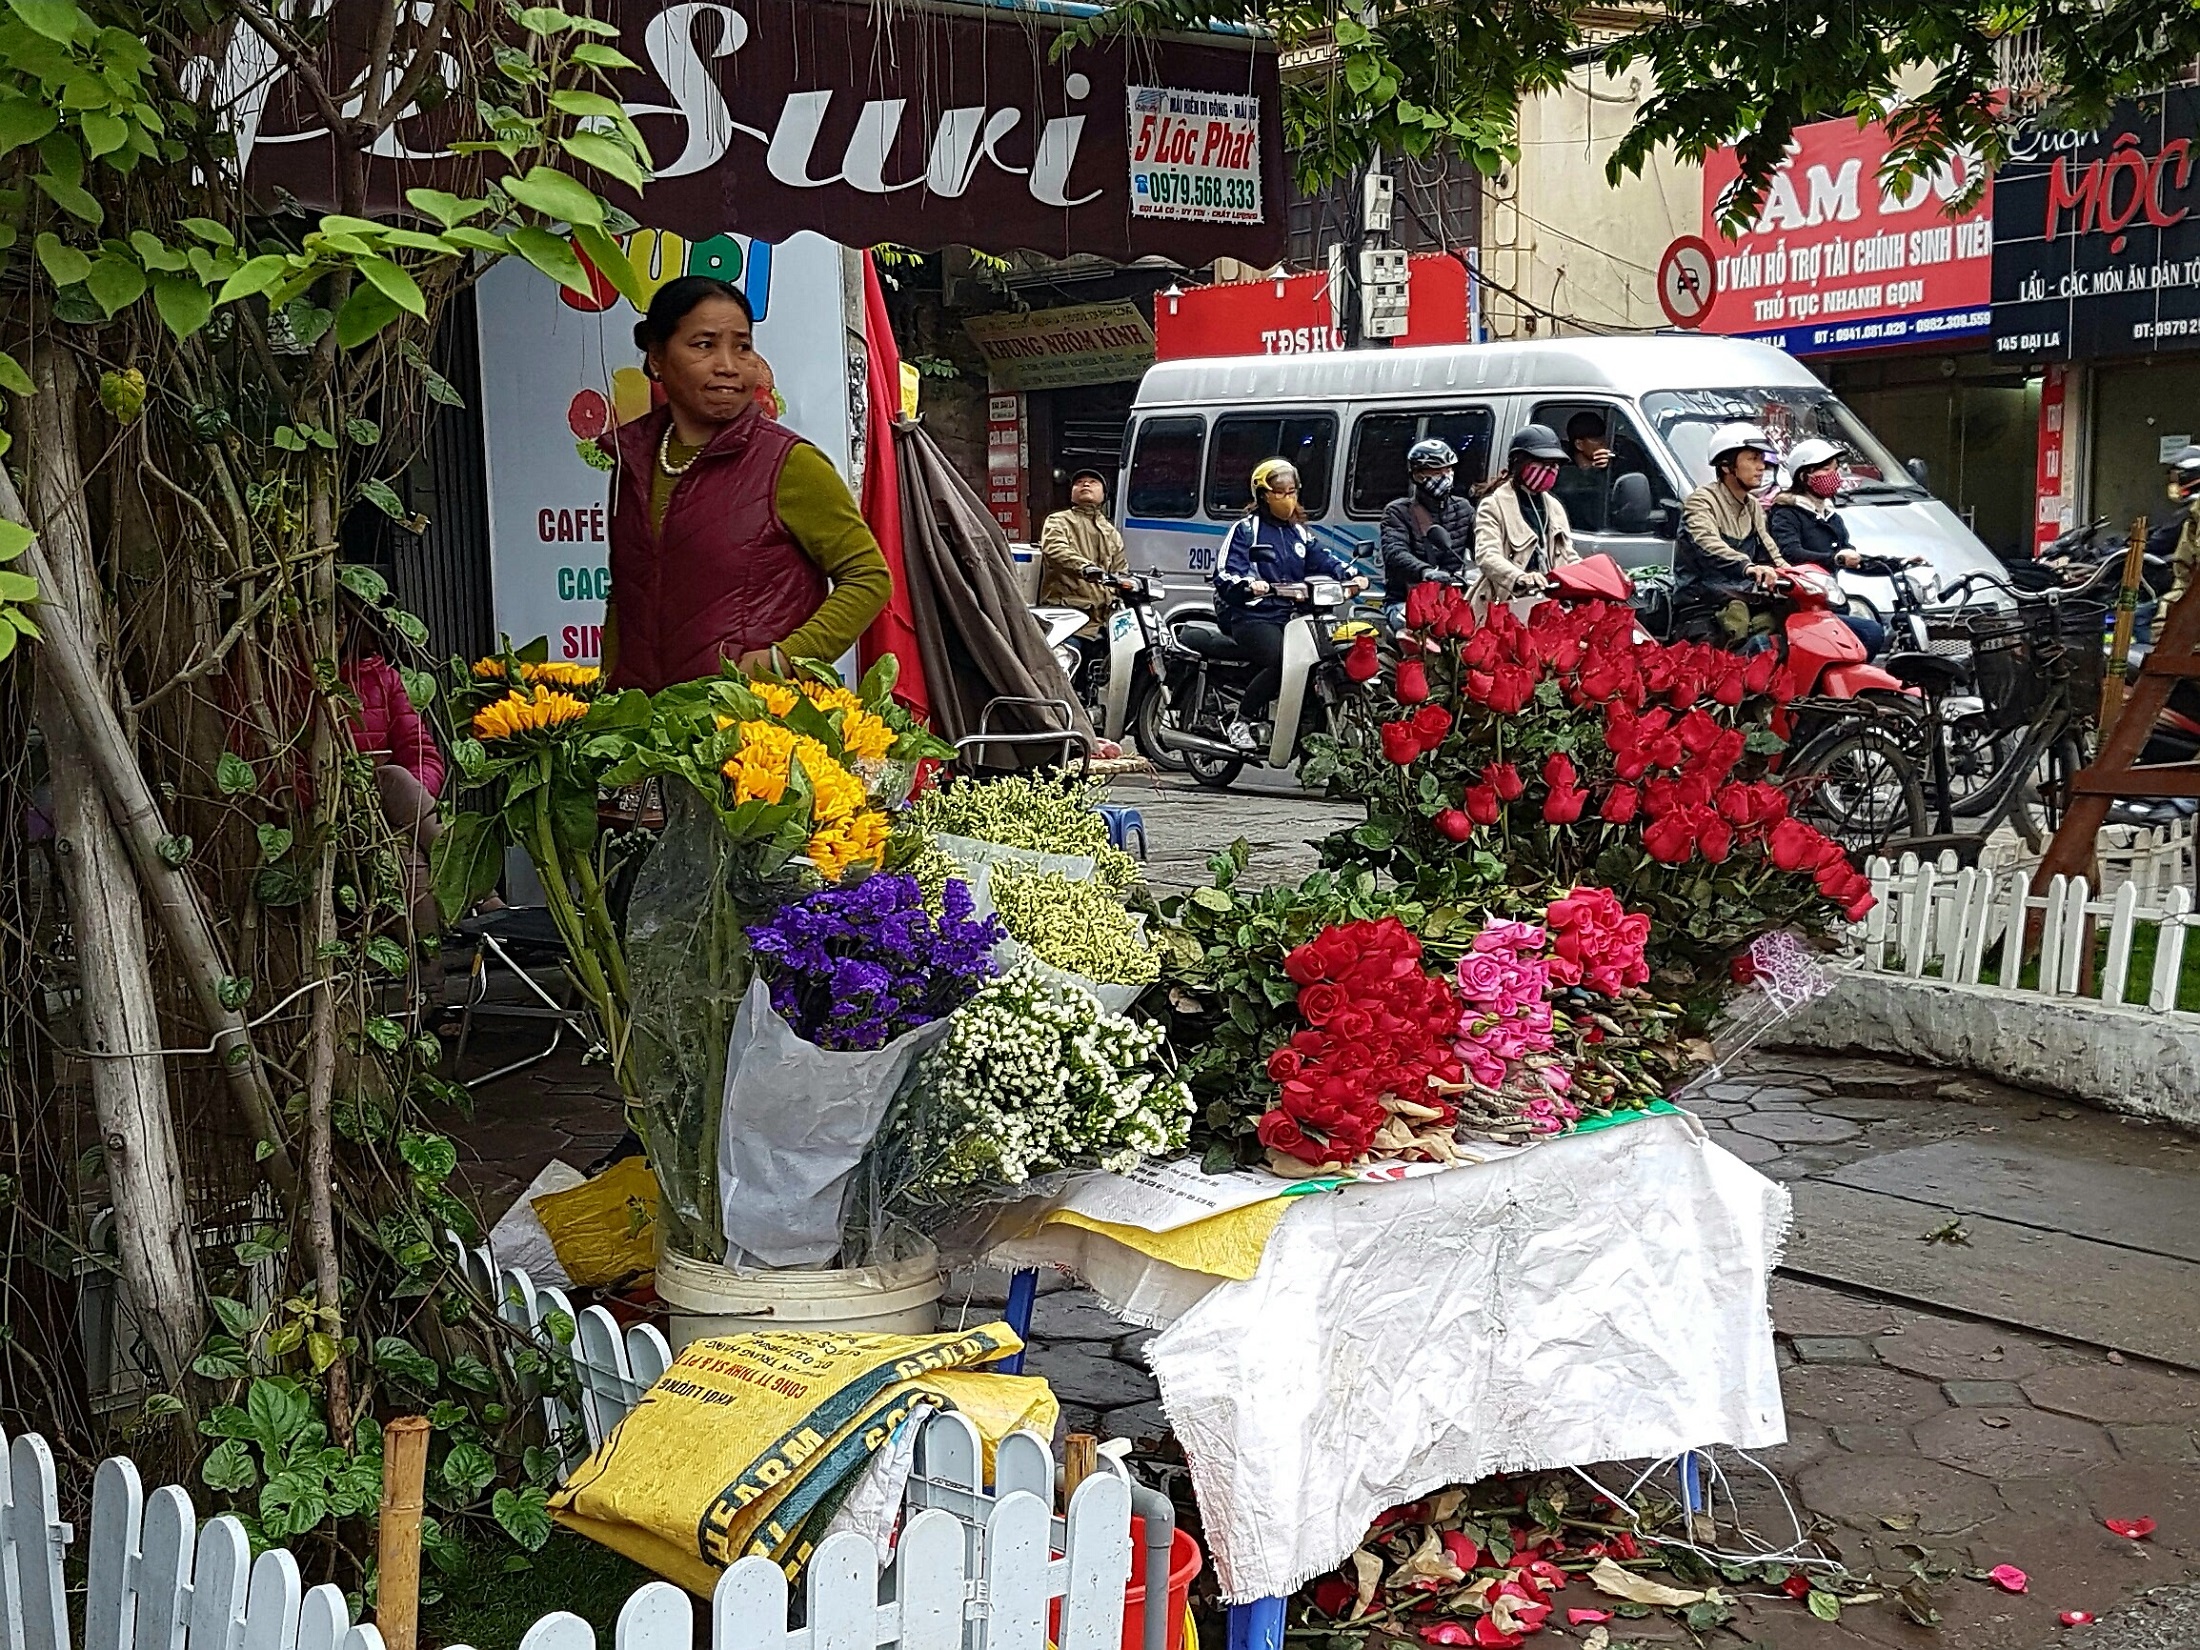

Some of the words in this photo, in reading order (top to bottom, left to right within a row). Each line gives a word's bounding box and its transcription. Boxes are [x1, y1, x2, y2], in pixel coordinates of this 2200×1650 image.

[578, 3, 1103, 206] Suri
[1135, 115, 1157, 162] 5
[1201, 121, 1256, 170] Phát
[1149, 172, 1256, 210] 0979.568.333
[2045, 132, 2193, 255] MỘC
[1731, 244, 1760, 291] VẤN
[1764, 237, 1787, 286] HỖ
[1790, 242, 1824, 288] TRỢ
[1823, 236, 1850, 279] TÀI
[1853, 229, 1906, 275] CHÍNH
[1908, 226, 1953, 267] SINH
[1754, 290, 1786, 322] THỦ
[1788, 293, 1821, 322] TỤC
[1822, 284, 1883, 314] NHANH
[1886, 280, 1925, 309] GỌN
[2020, 269, 2046, 301] LẨU
[2059, 268, 2090, 298] CÁC
[2093, 264, 2124, 295] MÓN
[2126, 263, 2148, 291] ĂN
[2151, 259, 2181, 288] DÂN
[1997, 335, 2018, 352] 145
[2020, 333, 2041, 353] ĐẠI
[2044, 332, 2061, 348] LA
[538, 503, 604, 543] CAFÉ
